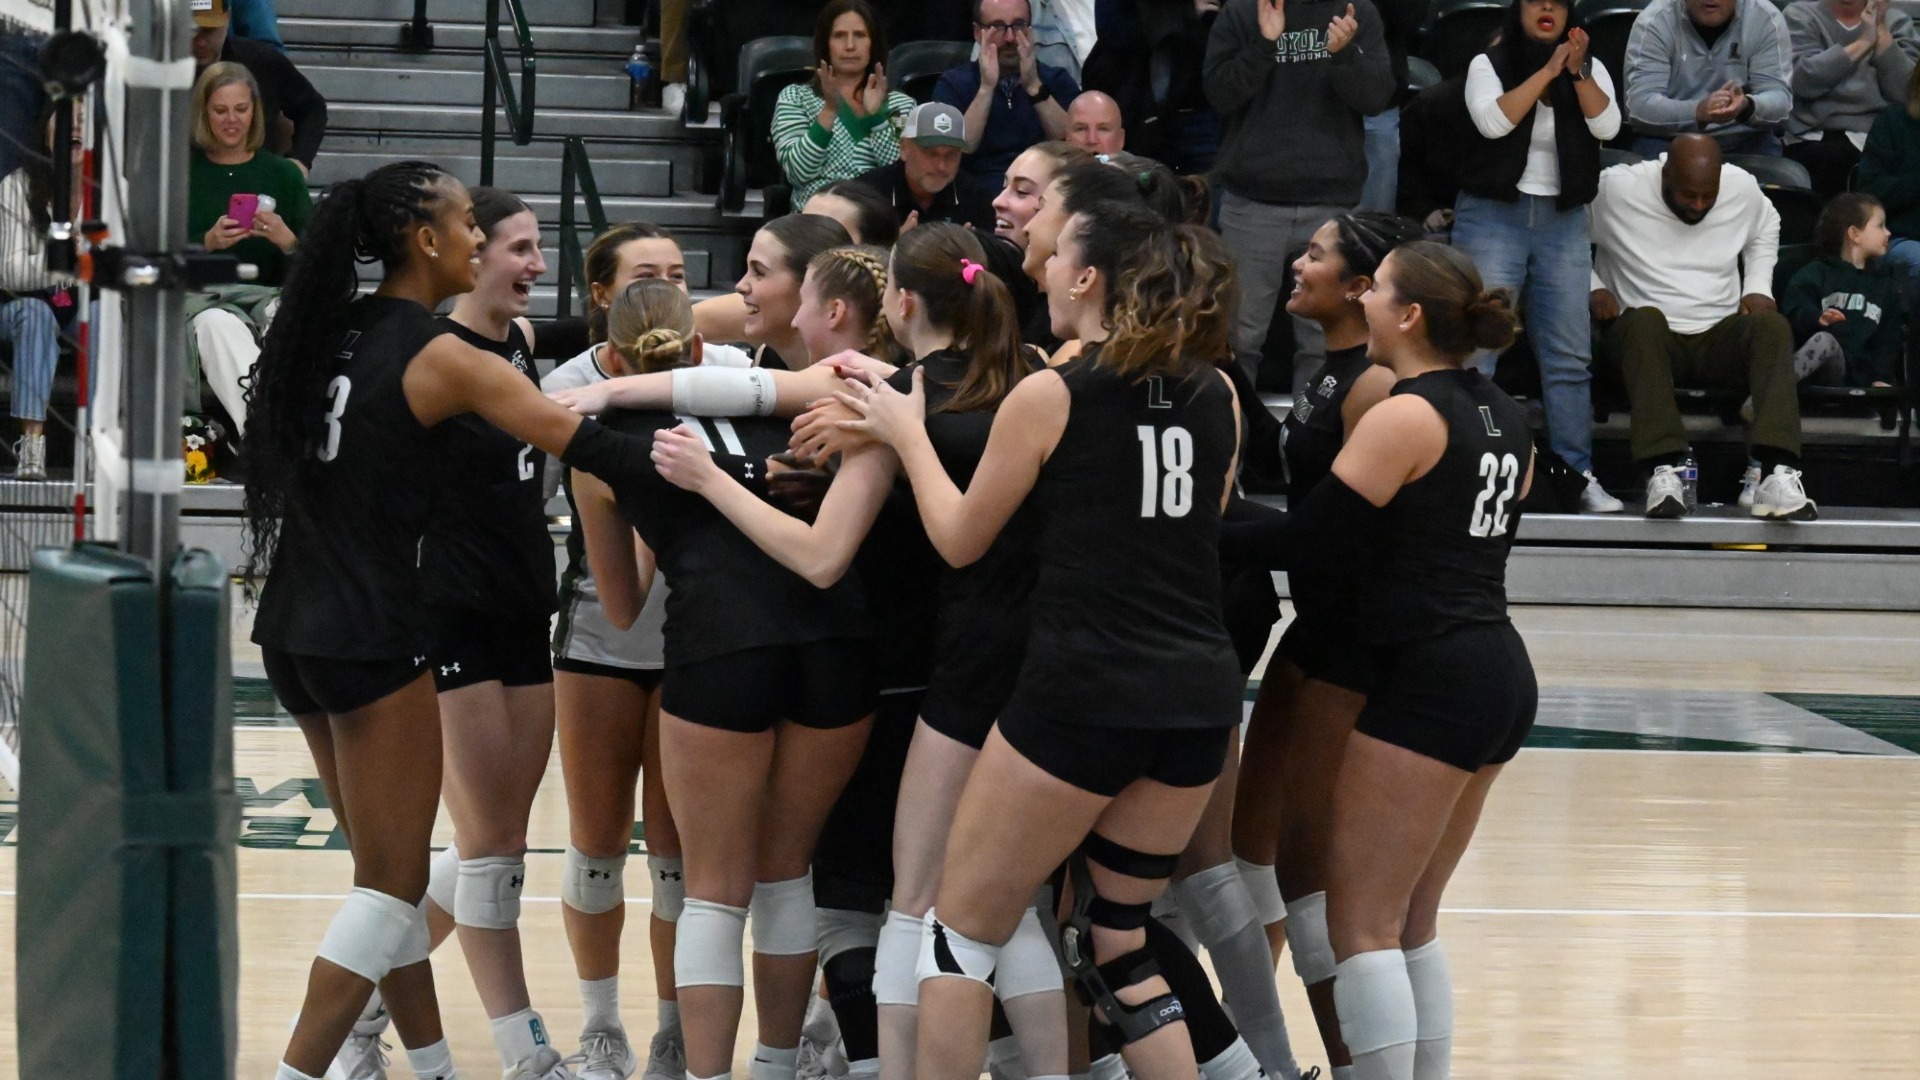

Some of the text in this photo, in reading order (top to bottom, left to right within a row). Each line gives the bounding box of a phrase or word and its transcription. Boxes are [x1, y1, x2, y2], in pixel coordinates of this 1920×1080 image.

[1276, 29, 1330, 54] OYOL
[1728, 42, 1741, 59] L
[1147, 376, 1172, 408] L
[316, 375, 351, 462] 3
[1478, 406, 1502, 436] L
[1137, 425, 1193, 518] 18
[1469, 452, 1518, 537] 22
